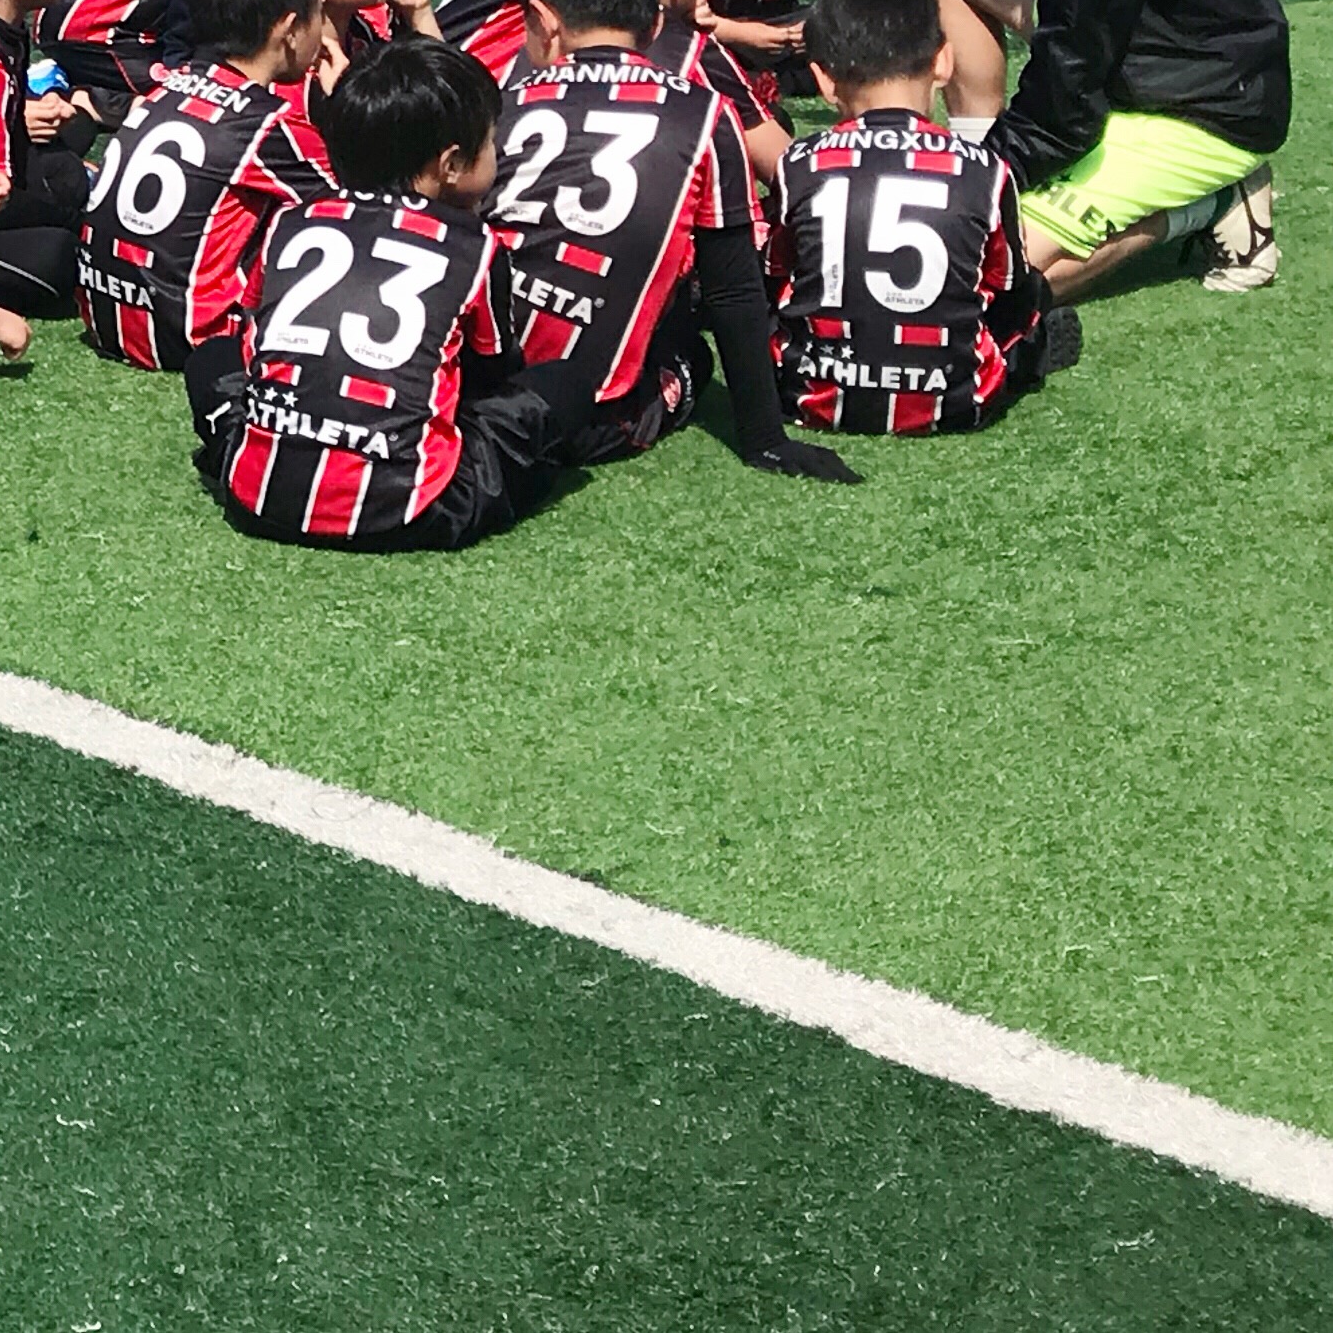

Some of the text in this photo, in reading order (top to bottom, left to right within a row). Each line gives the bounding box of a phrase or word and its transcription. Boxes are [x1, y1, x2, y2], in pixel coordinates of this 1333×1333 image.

[487, 109, 660, 236] 23
[789, 130, 989, 167] Z.MINGXUAN
[811, 174, 950, 314] 15
[260, 226, 450, 370] 23
[797, 355, 948, 392] ATHLETA
[246, 398, 390, 460] ATHLETA
